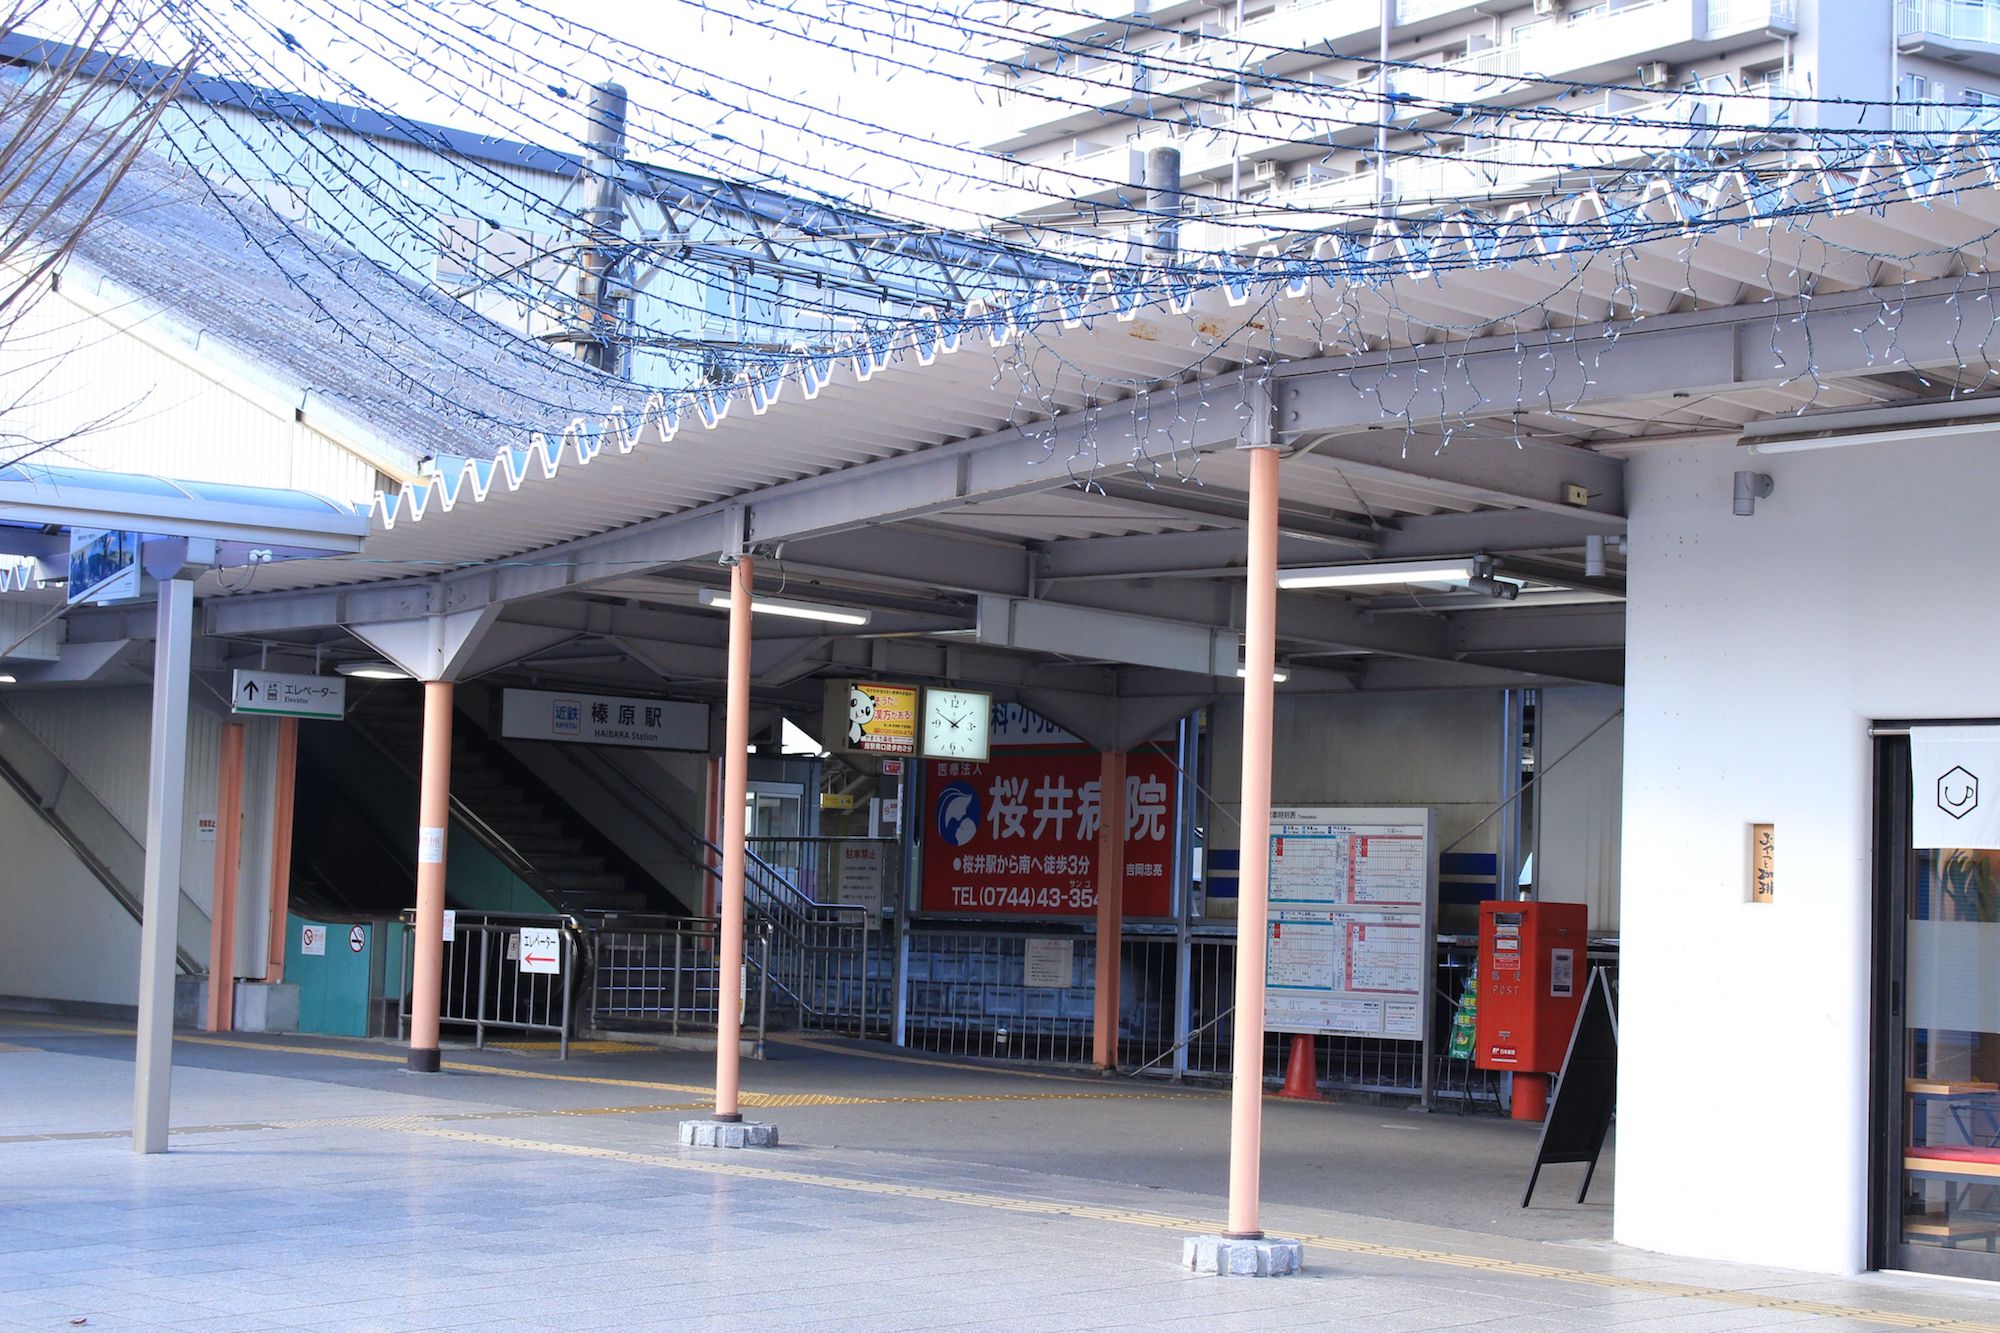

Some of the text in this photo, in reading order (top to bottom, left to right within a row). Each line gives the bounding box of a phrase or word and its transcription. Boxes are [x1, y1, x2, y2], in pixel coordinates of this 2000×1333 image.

[285, 684, 338, 697] エレベーター
[950, 699, 959, 709] 12
[555, 705, 579, 722] 近鉄
[591, 702, 662, 728] 榛原駅
[935, 719, 973, 731] 9 3
[594, 729, 658, 742] HAIBARA Station
[949, 742, 956, 751] 6
[937, 763, 983, 776] 医療法人
[524, 934, 556, 949] エレベーター
[1493, 985, 1519, 995] POST
